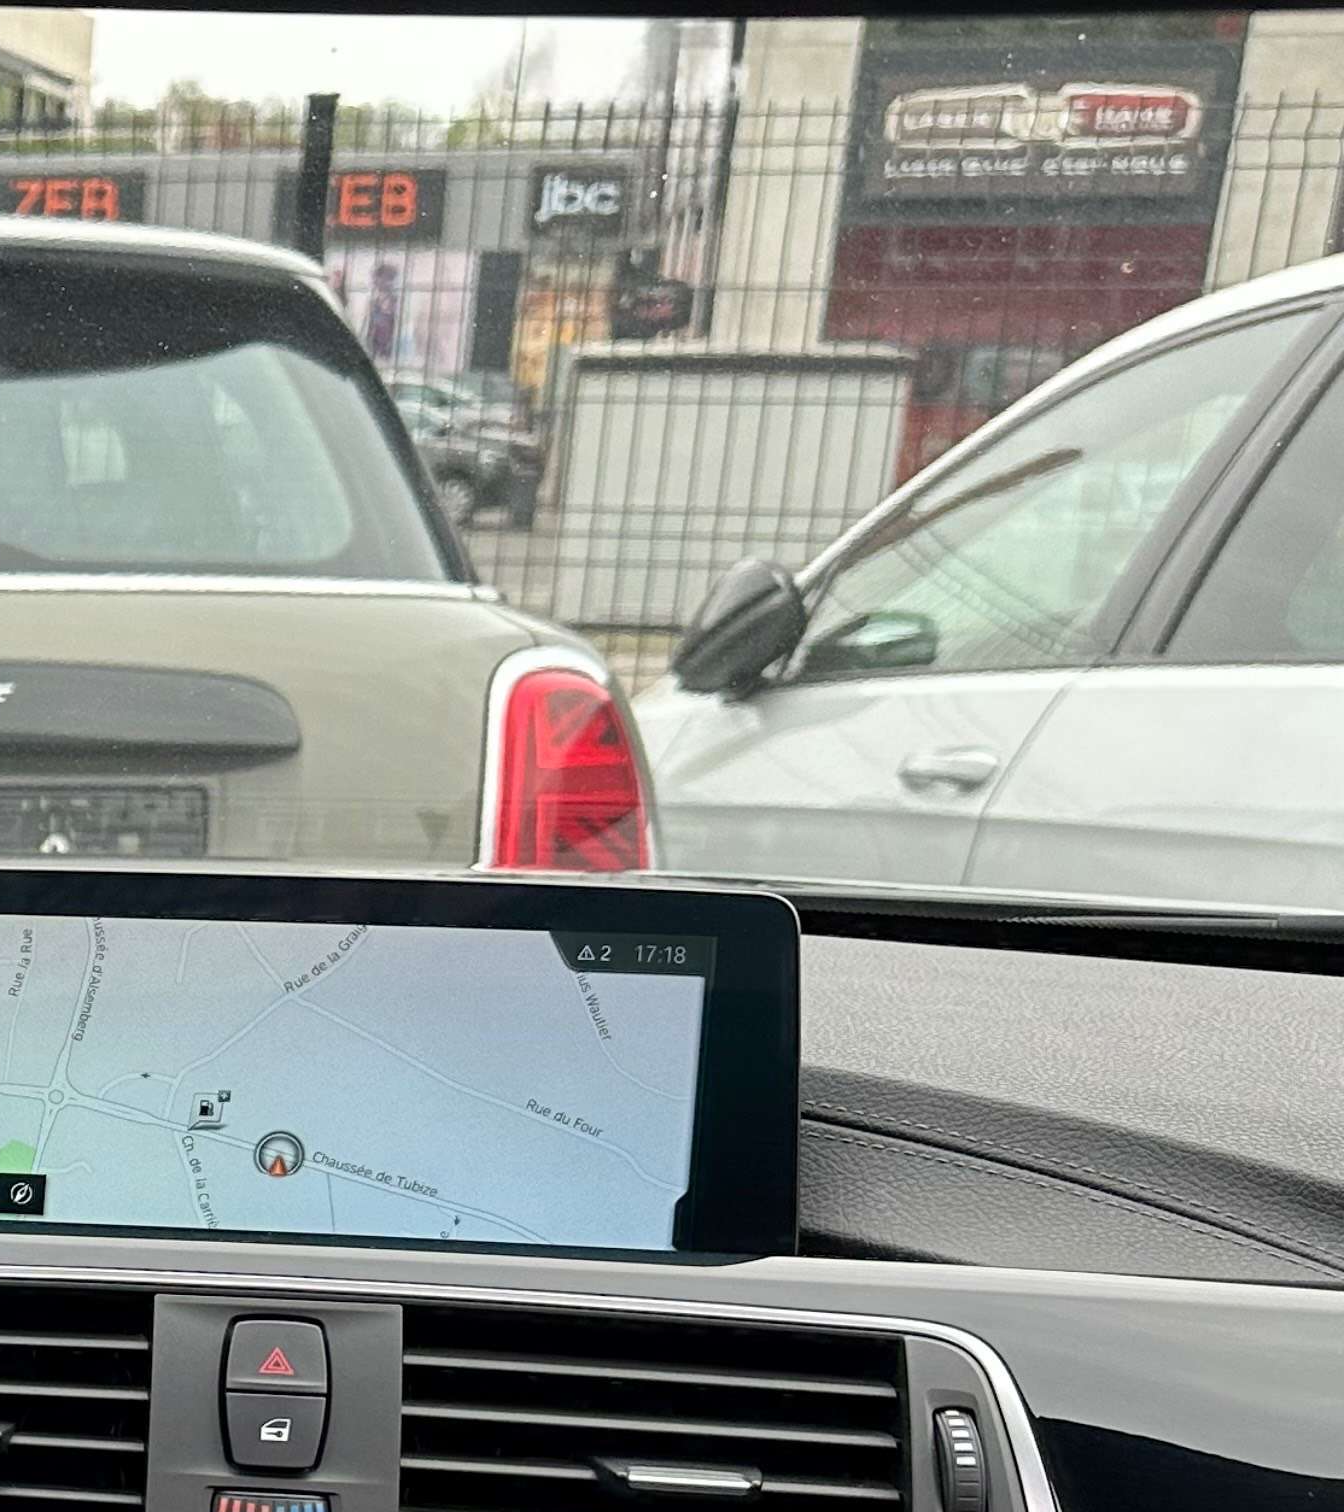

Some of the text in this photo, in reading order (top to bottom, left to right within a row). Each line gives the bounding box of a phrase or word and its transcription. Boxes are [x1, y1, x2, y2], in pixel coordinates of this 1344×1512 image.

[326, 172, 417, 228] EB
[534, 171, 621, 225] jbc
[8, 928, 33, 997] Rue la Rue
[283, 974, 311, 993] Rue
[312, 961, 328, 976] de
[326, 952, 341, 965] la
[600, 945, 612, 961] 2
[634, 944, 686, 964] 17:18
[526, 1098, 604, 1138] Rue du Four
[188, 1158, 202, 1174] de
[195, 1178, 207, 1190] la
[312, 1151, 439, 1198] Chaussée de Tubize
